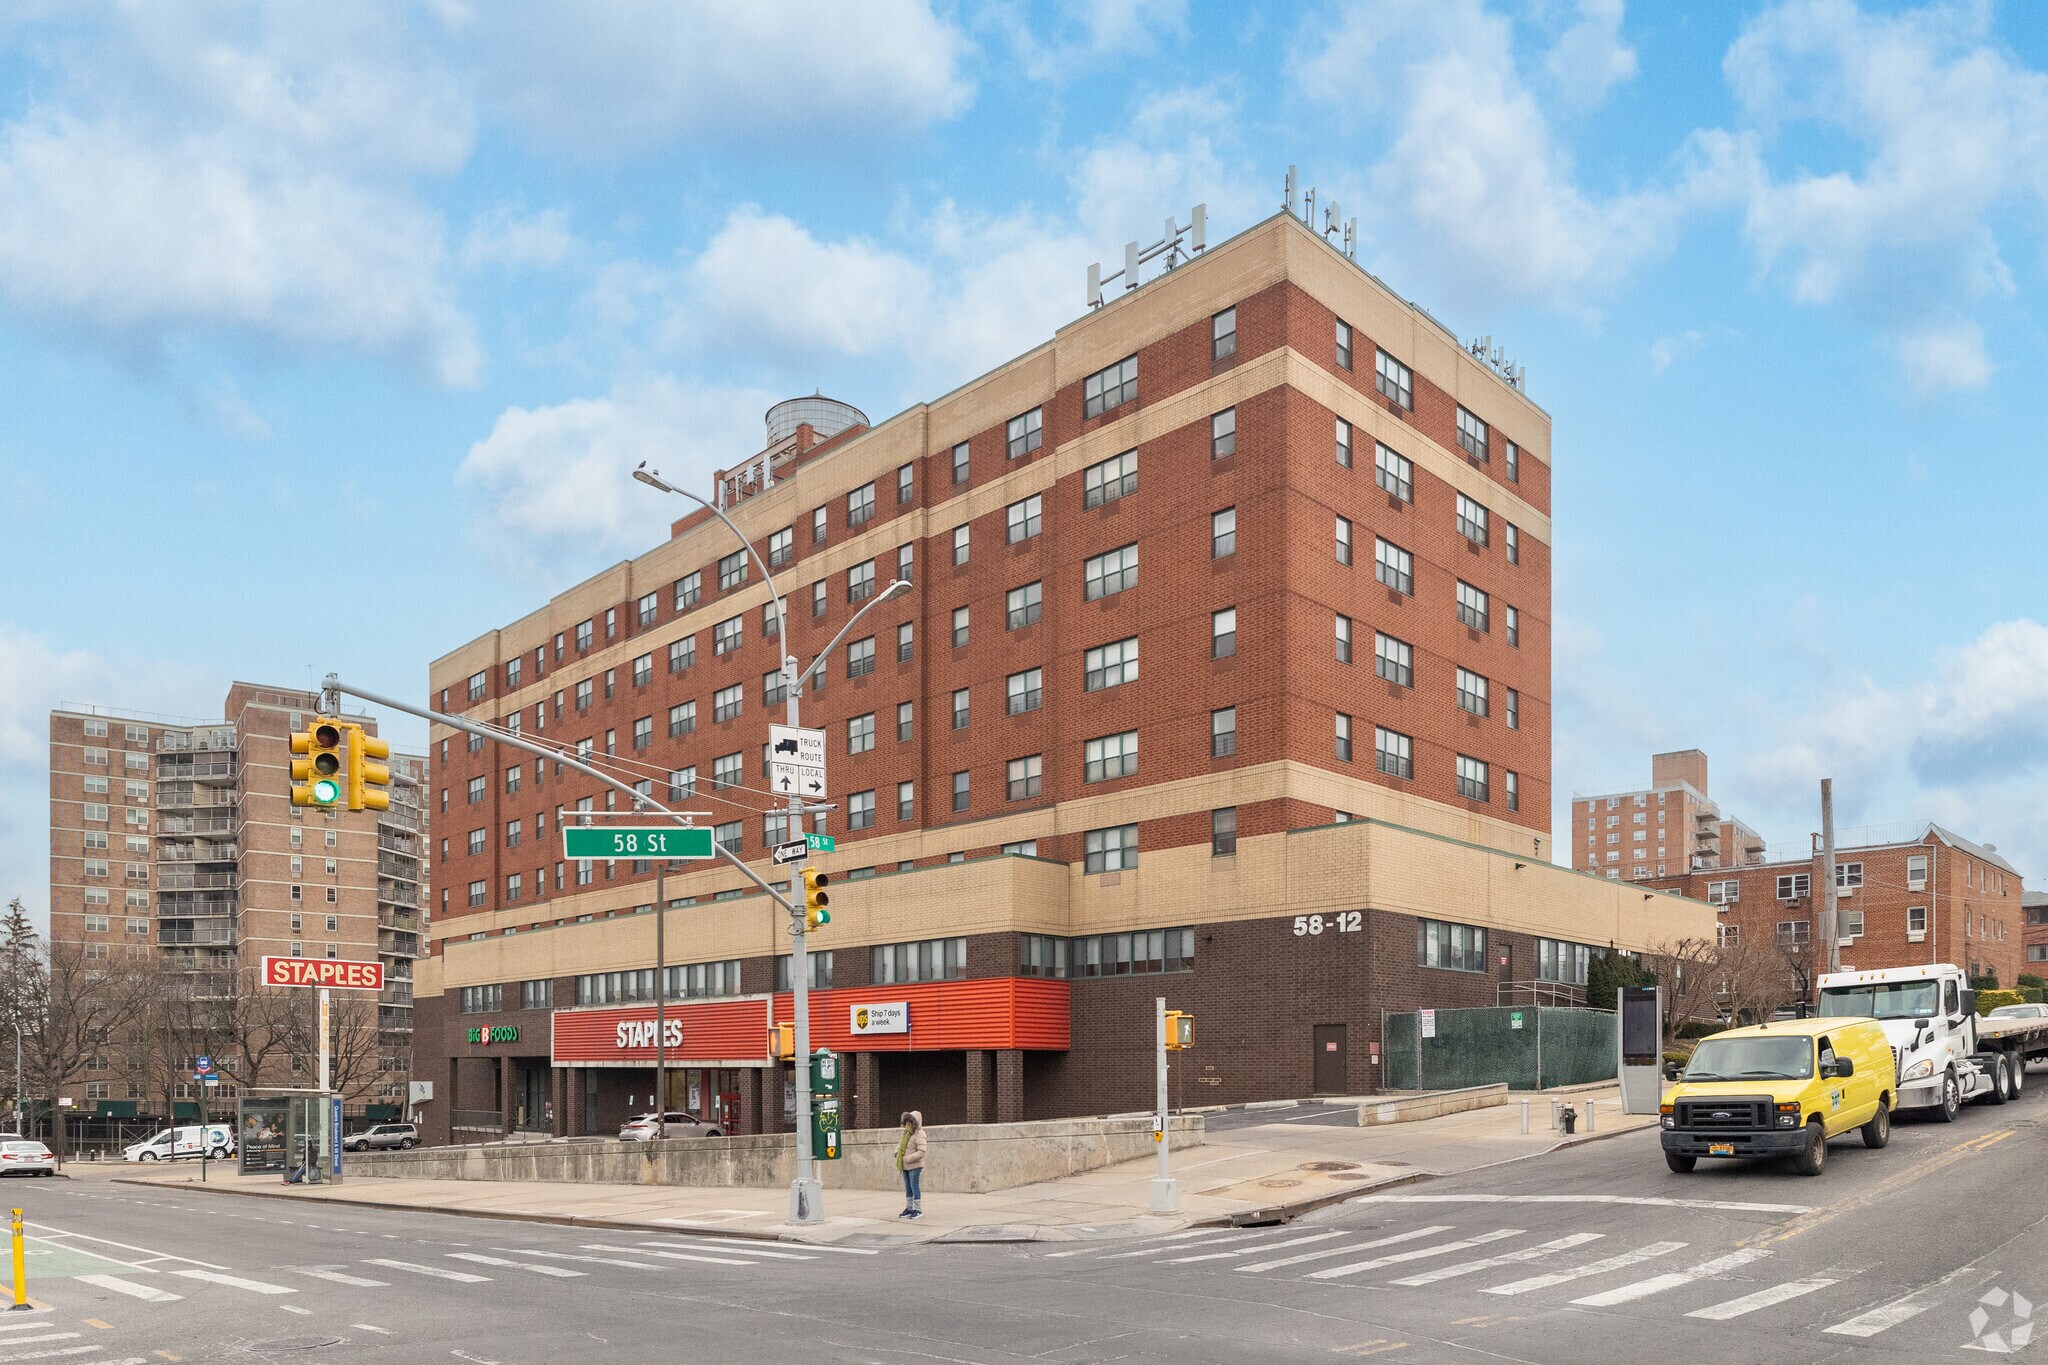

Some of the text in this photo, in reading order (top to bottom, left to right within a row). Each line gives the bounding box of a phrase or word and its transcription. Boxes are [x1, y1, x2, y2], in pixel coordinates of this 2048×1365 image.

[800, 738, 822, 748] TRUCK
[800, 752, 822, 762] ROUTE
[776, 764, 824, 779] THRU LOCAL
[614, 834, 667, 852] 58 St
[810, 835, 821, 848] 58
[777, 845, 804, 859] ONE WAY
[1293, 911, 1362, 936] 58-12
[273, 961, 377, 986] STAPLES
[871, 1010, 884, 1018] Ship
[888, 1009, 901, 1018] days
[482, 1027, 490, 1042] B
[490, 1026, 518, 1042] FOODS
